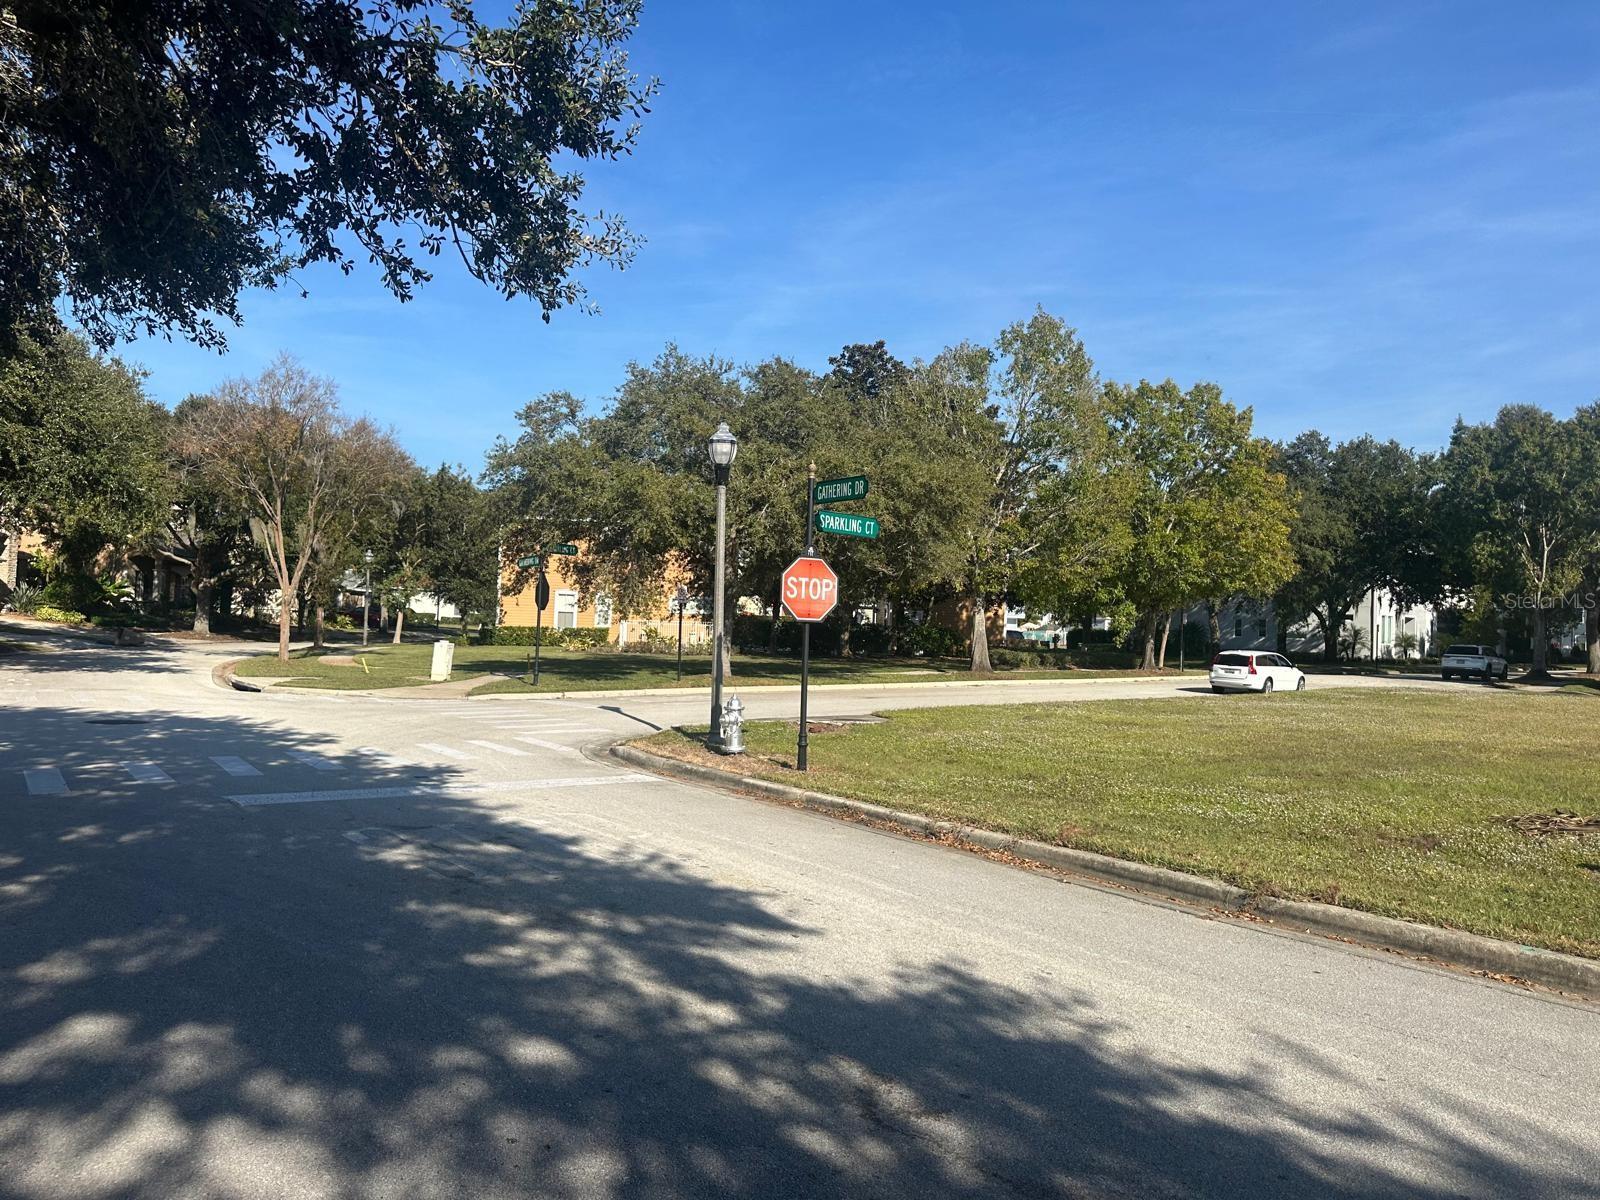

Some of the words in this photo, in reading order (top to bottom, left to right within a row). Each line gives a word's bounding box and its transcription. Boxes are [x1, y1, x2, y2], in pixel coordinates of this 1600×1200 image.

[817, 482, 851, 500] GATHERING
[855, 480, 863, 495] DR
[819, 514, 862, 533] SPARKLING
[865, 521, 874, 535] CT
[786, 576, 833, 601] STOP
